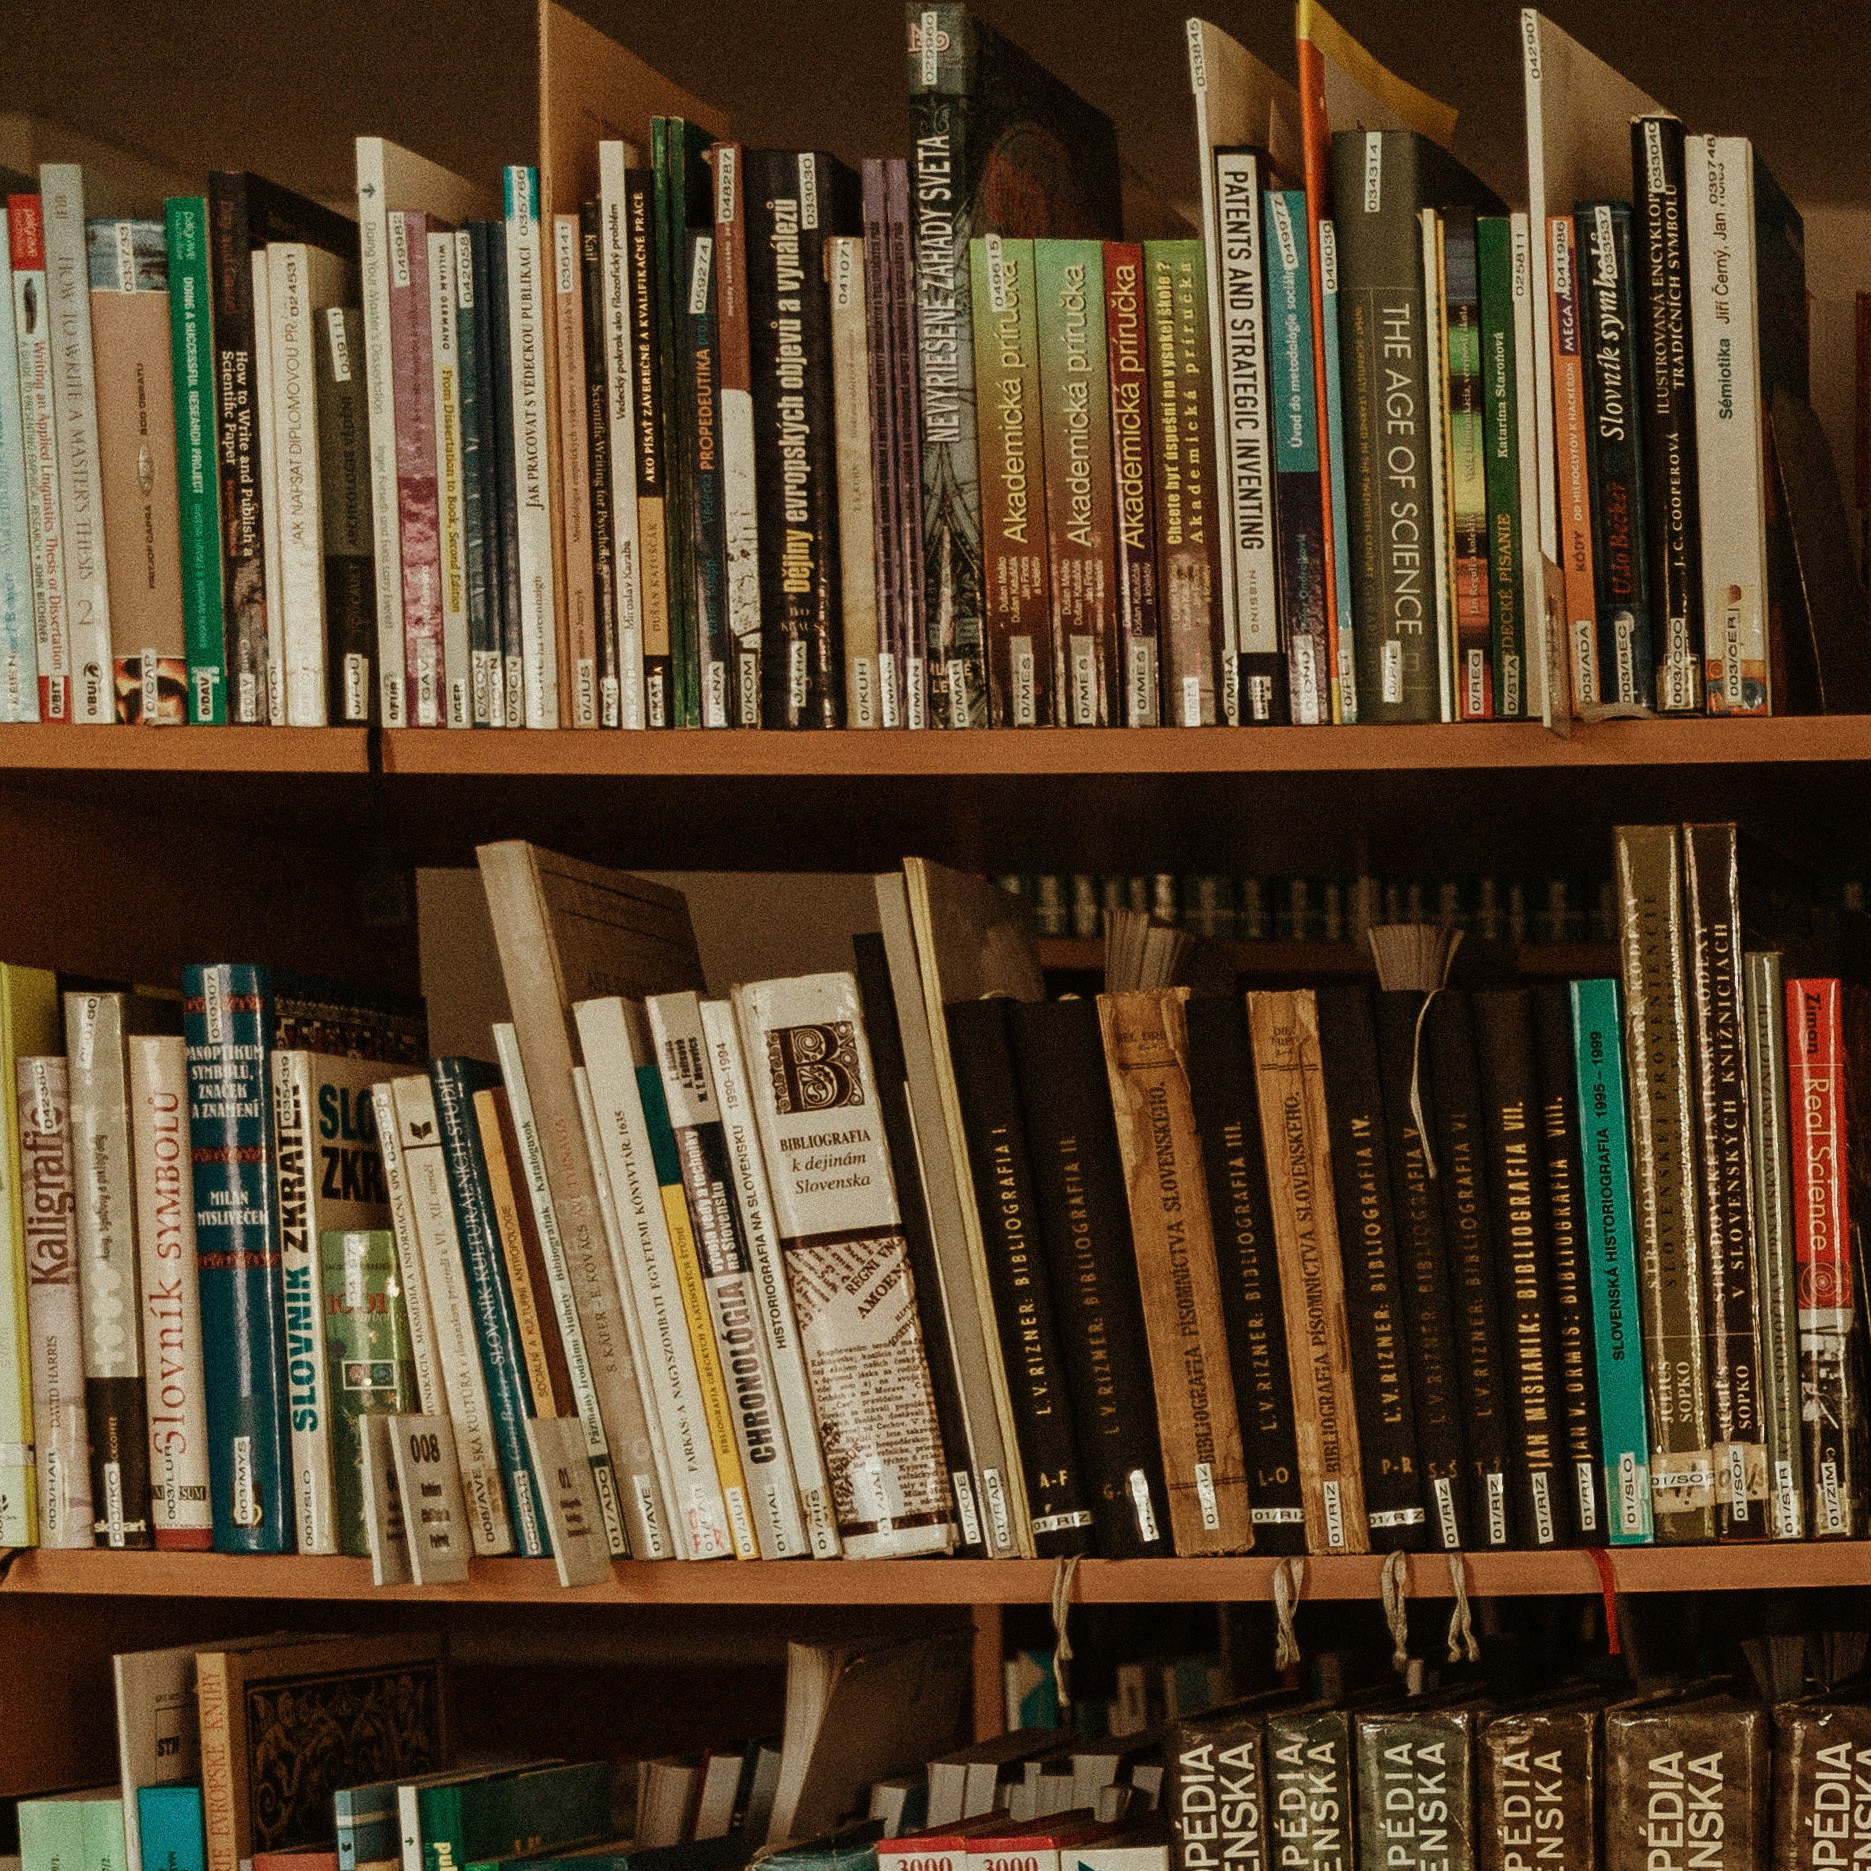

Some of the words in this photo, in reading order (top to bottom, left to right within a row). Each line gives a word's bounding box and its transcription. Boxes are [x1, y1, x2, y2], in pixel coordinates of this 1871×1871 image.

[769, 198, 804, 290] vynálezů
[1224, 171, 1251, 259] PATENTS
[783, 298, 800, 311] a
[1060, 266, 1089, 372] príručka
[1228, 268, 1253, 309] AND
[770, 317, 806, 389] objevů
[1383, 303, 1410, 358] THE
[1231, 319, 1258, 428] STRATEGIC
[1385, 369, 1413, 434] AGE
[777, 403, 811, 521] evropských
[1064, 383, 1092, 547] Akademická
[1238, 439, 1265, 548] INVENTING
[1388, 446, 1415, 488] OF
[781, 527, 814, 590] Dějiny
[1390, 502, 1421, 636] SCIENCE
[780, 1130, 870, 1151] BIBLIOGRAFIA
[1804, 1077, 1830, 1135] Real
[792, 1157, 800, 1171] k
[804, 1152, 866, 1171] dejinám
[797, 1175, 871, 1192] Slovenska
[1806, 1145, 1836, 1251] Science
[717, 1280, 777, 1464] CHRONOLÓGIA
